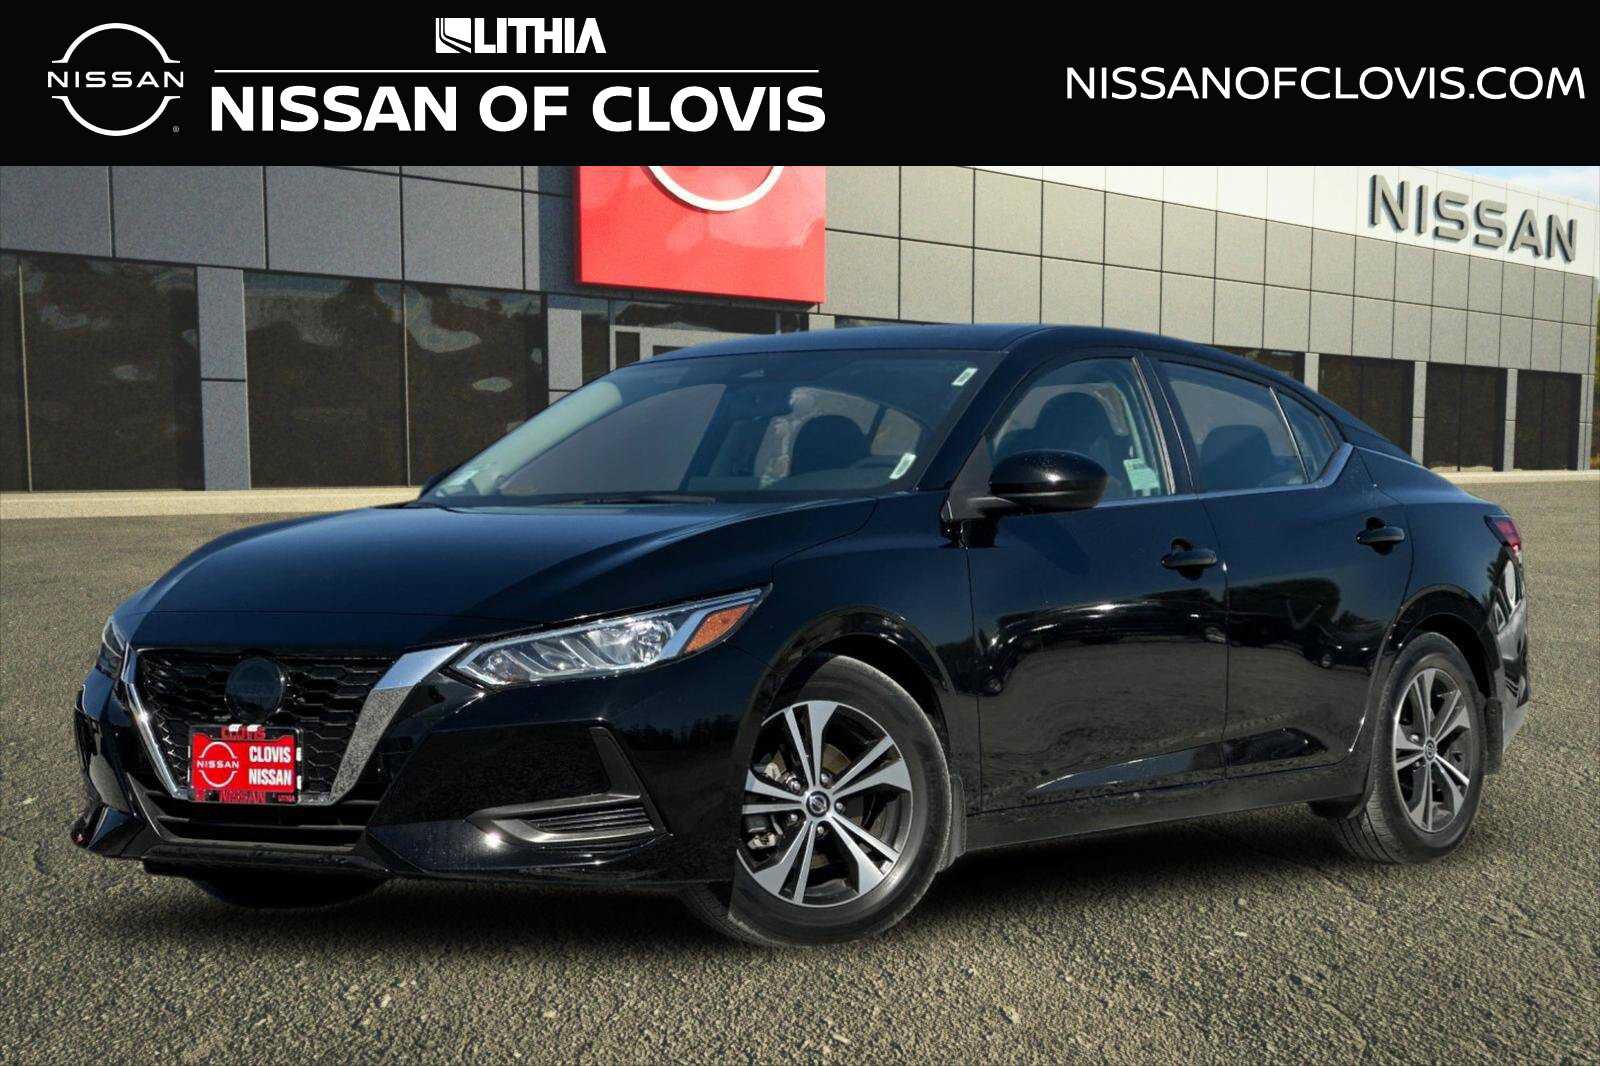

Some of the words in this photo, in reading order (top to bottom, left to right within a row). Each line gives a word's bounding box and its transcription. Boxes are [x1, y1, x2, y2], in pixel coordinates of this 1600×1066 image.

[1369, 174, 1577, 262] NISSAN
[249, 746, 291, 762] CLOVIS
[197, 760, 239, 768] NISSAN
[249, 769, 291, 785] NISSAN
